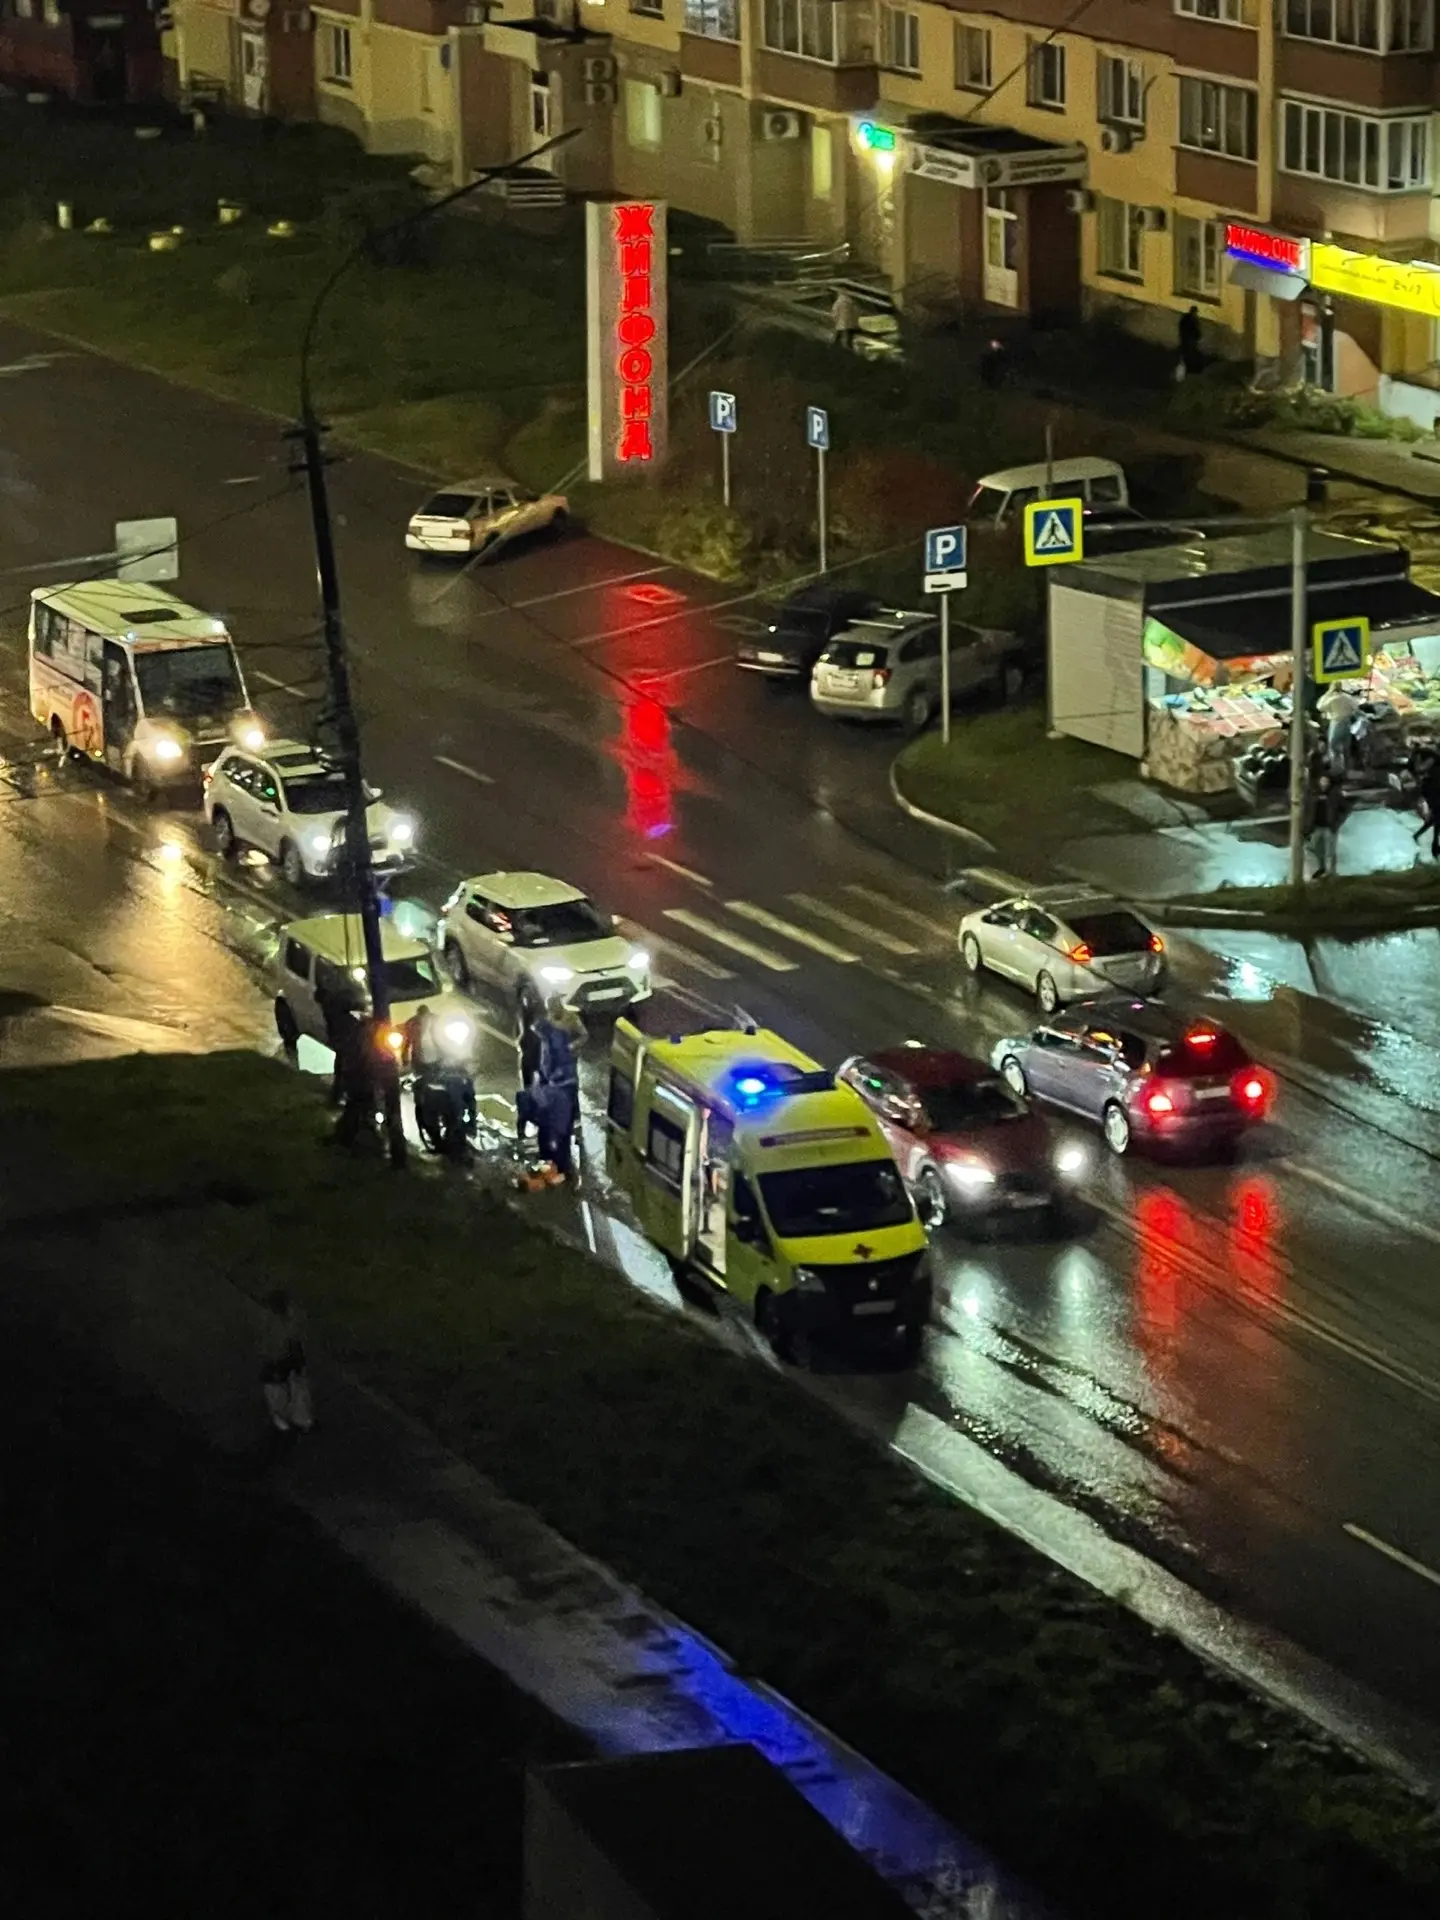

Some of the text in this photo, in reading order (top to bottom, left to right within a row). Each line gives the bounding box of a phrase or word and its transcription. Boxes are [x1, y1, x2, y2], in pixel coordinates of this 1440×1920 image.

[614, 205, 655, 462] ЖИЛФОНД
[716, 396, 730, 425] P
[812, 414, 824, 441] P
[935, 534, 957, 565] P
